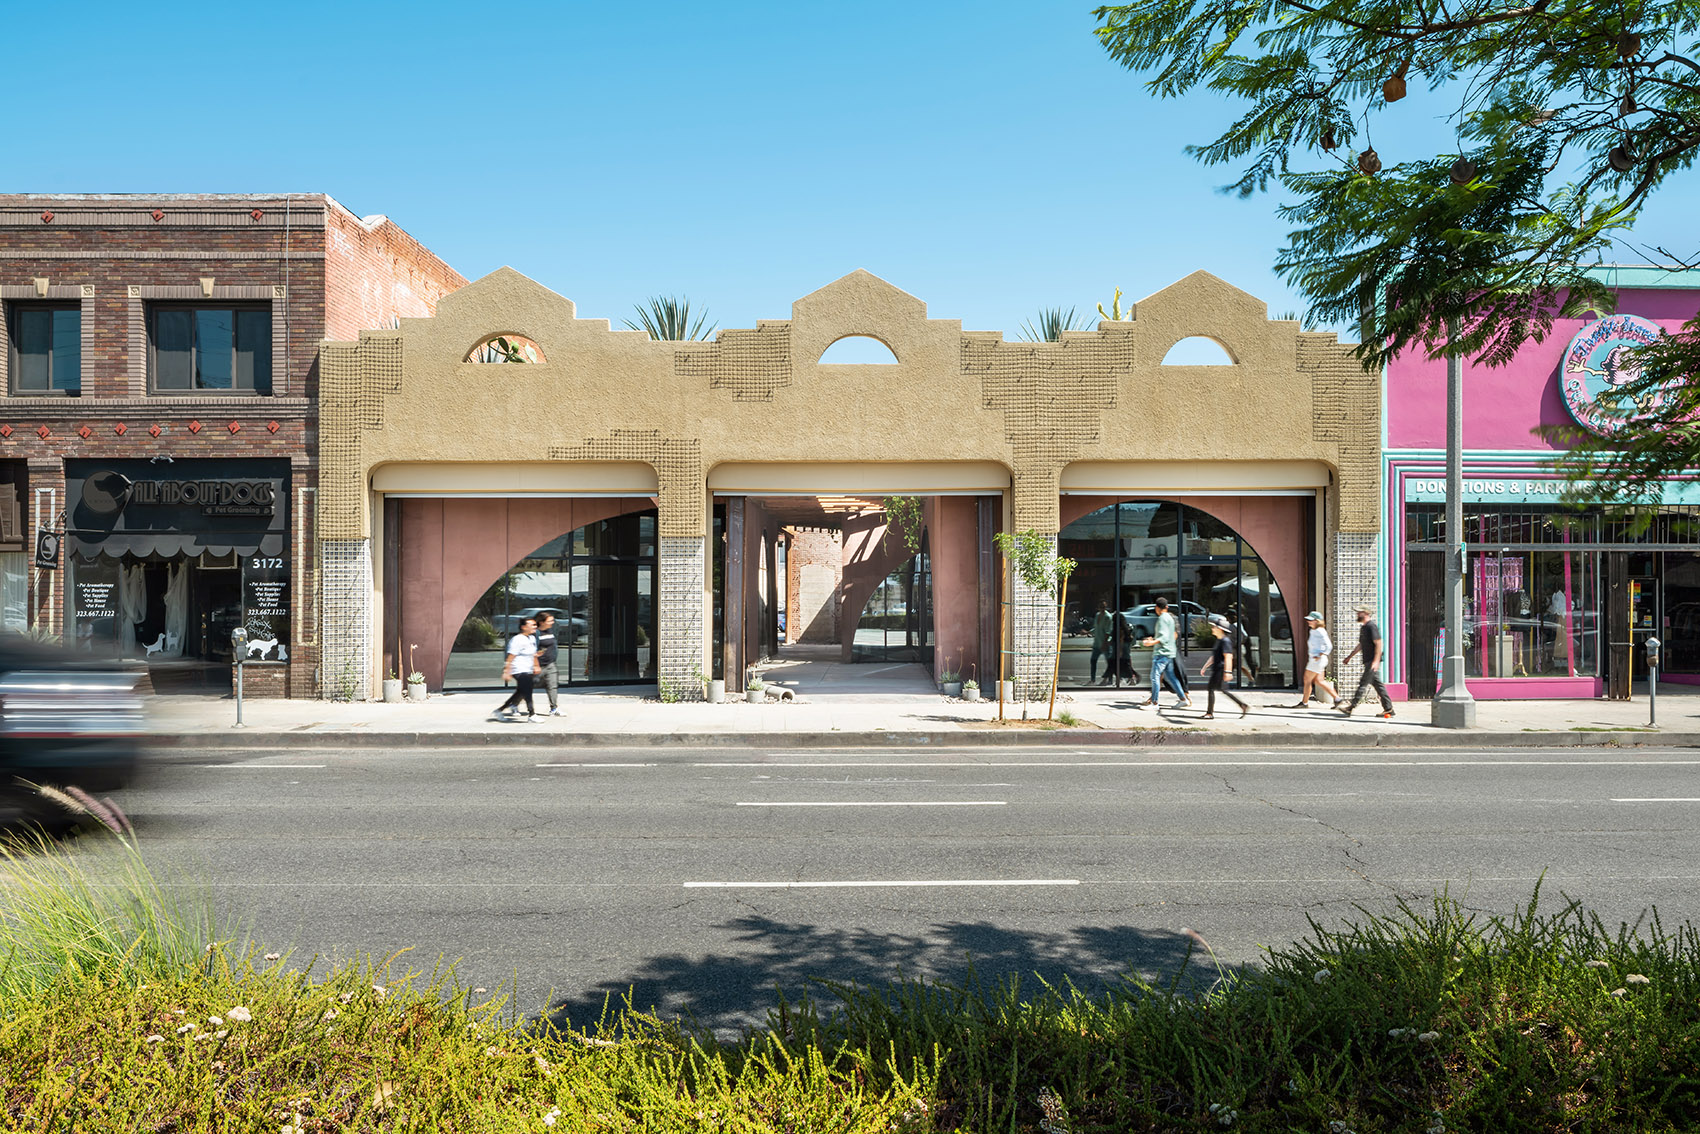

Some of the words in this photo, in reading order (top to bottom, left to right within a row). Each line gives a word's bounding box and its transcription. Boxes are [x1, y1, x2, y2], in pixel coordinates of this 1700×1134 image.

[1416, 481, 1504, 493] DONTIONS
[1509, 481, 1520, 493] &
[134, 481, 157, 503] ALL
[160, 481, 216, 505] ABOUT
[220, 481, 272, 505] DOGS
[228, 506, 260, 514] Grooming
[253, 558, 283, 568] 3172
